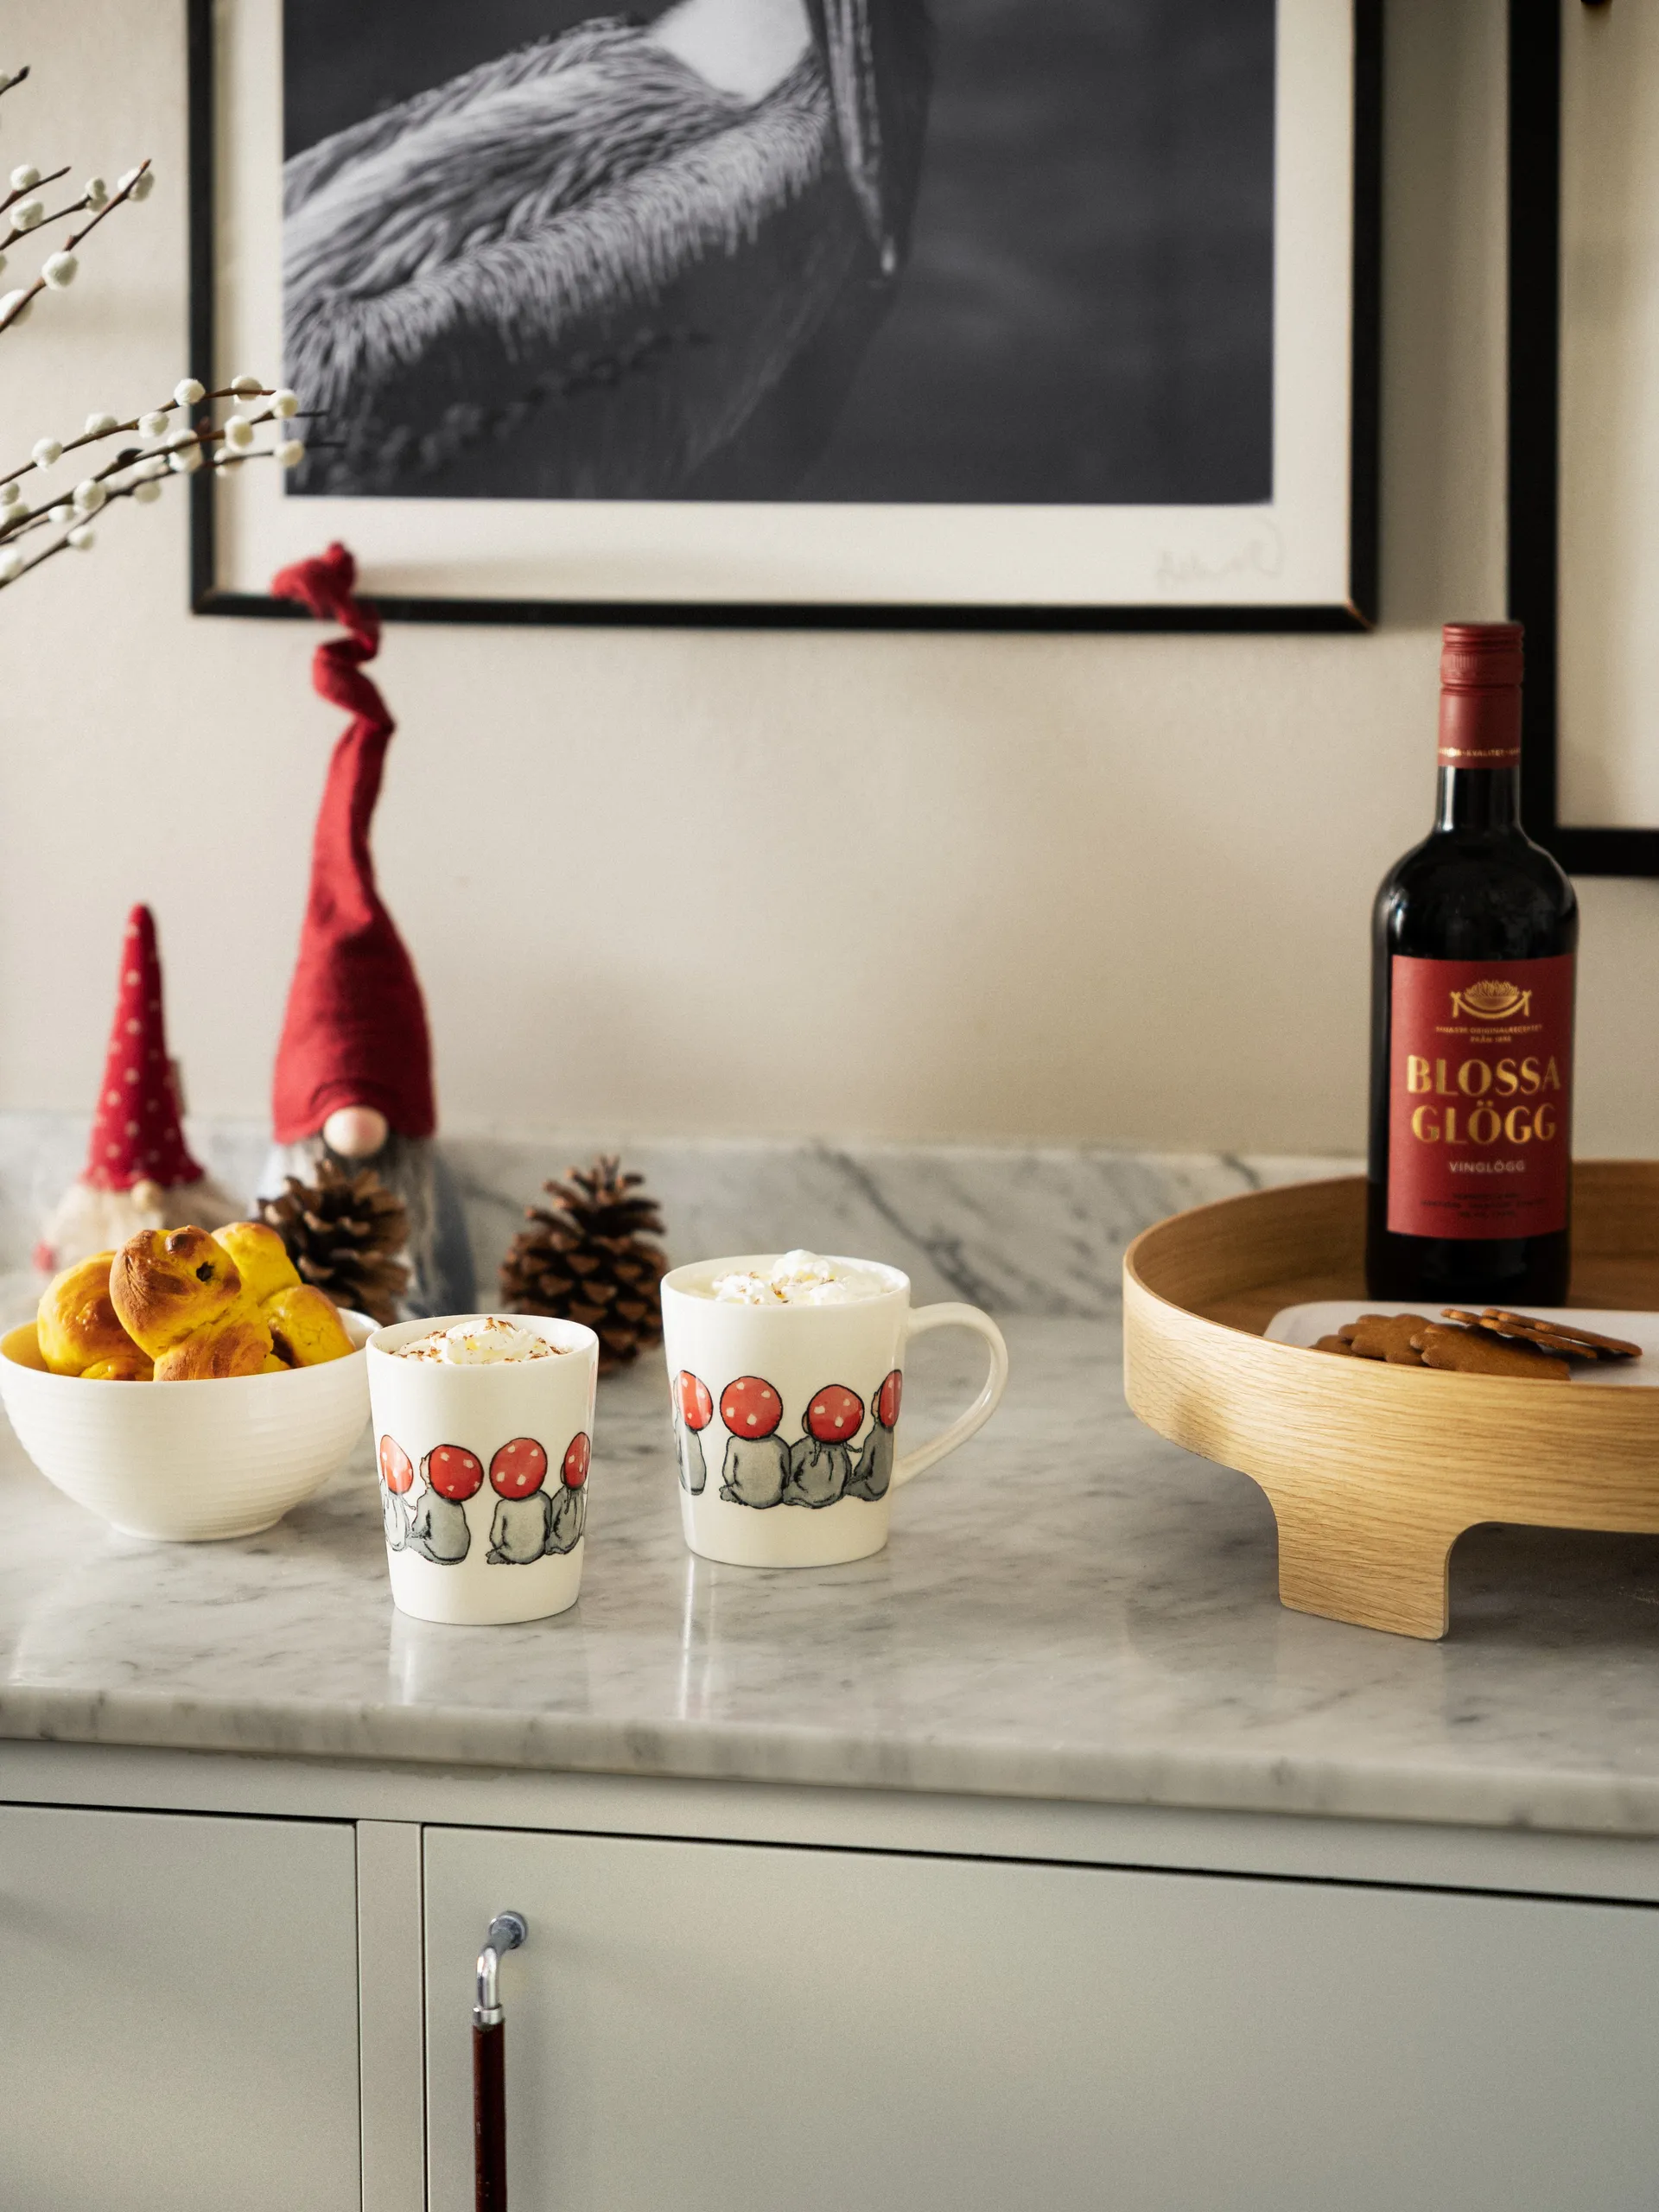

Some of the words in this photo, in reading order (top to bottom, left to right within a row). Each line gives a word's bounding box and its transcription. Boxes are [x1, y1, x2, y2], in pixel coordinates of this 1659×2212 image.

[1407, 1054, 1561, 1096] BLOSSA
[1411, 1100, 1556, 1145] GLÖGG
[1449, 1160, 1526, 1173] VINGLÖGG
